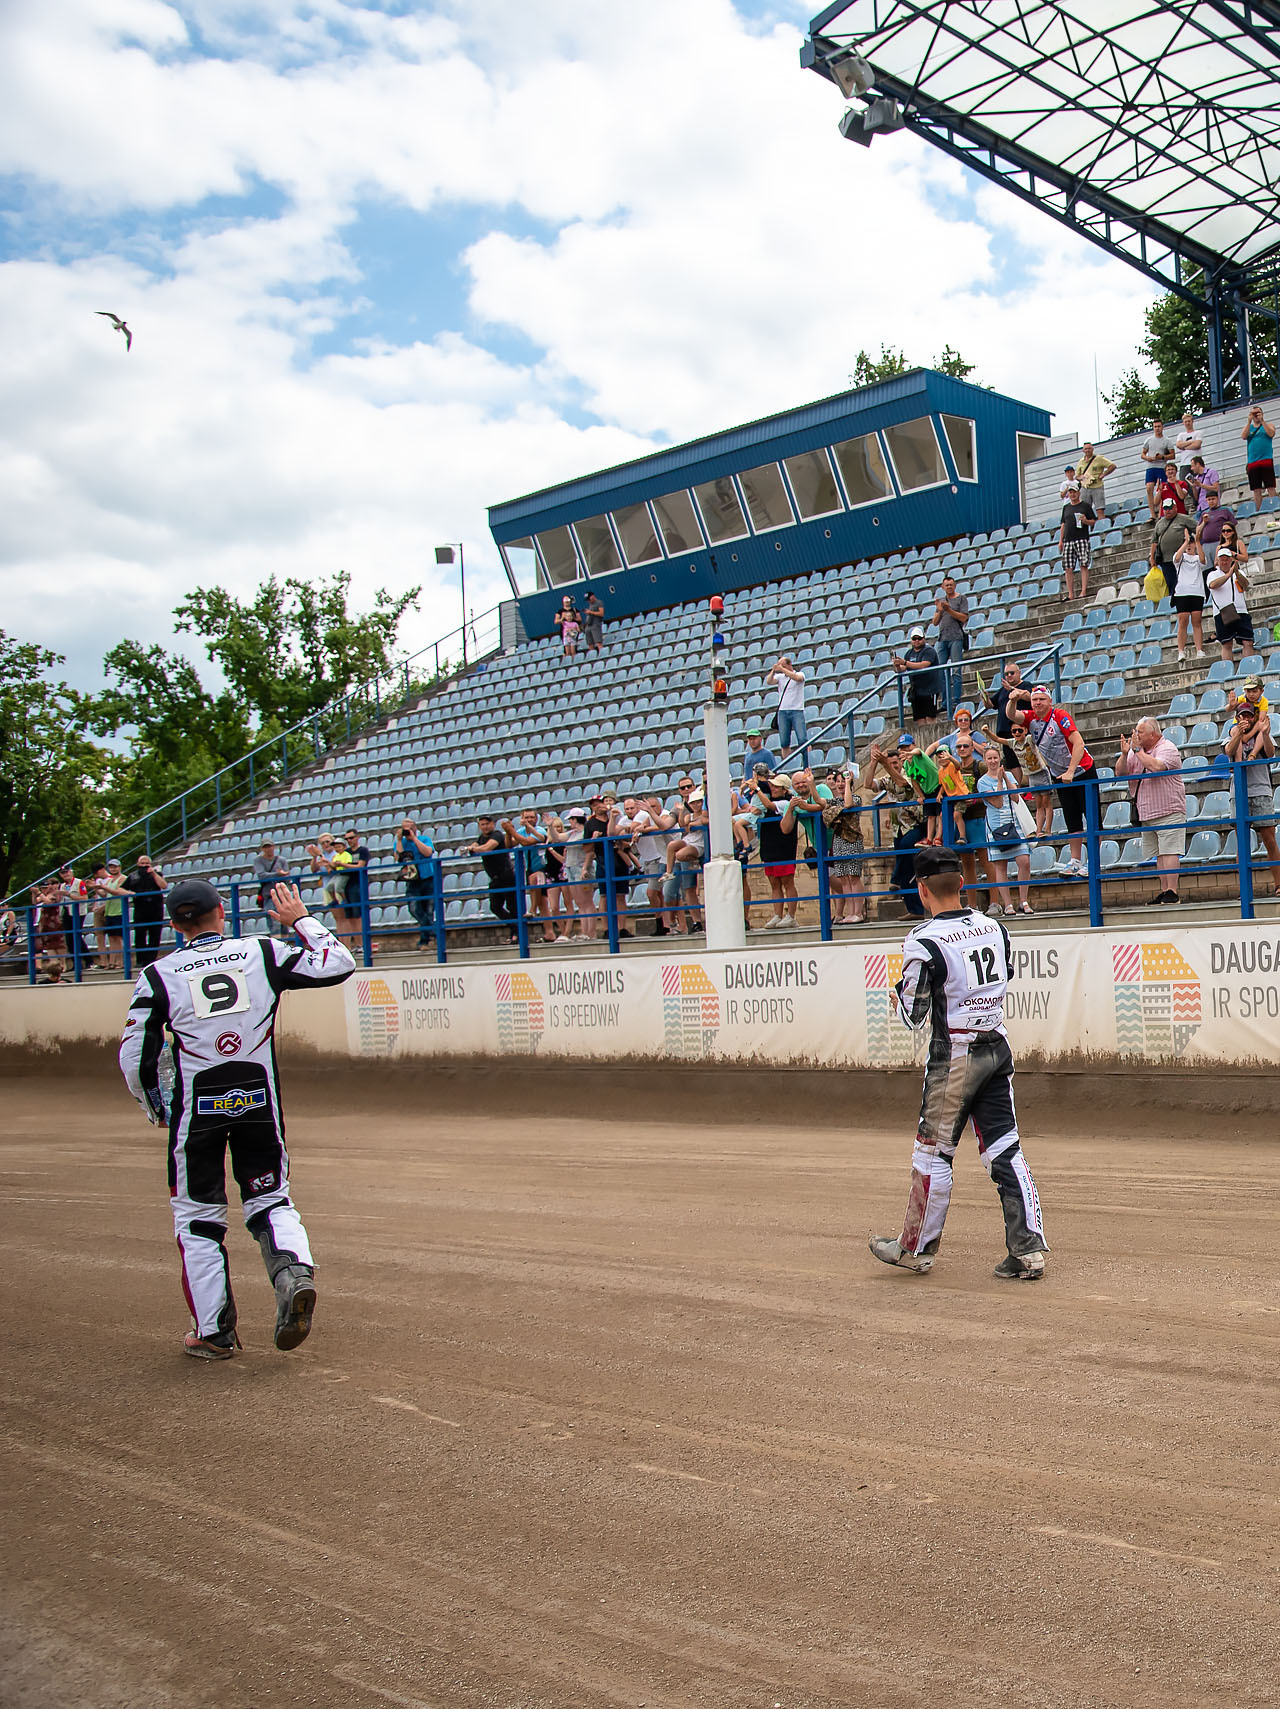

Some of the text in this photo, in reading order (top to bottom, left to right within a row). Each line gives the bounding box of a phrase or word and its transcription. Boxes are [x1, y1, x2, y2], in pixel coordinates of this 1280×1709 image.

[940, 923, 1000, 944] MIHAILOV
[174, 952, 249, 974] KOSTIGOV
[725, 960, 818, 990] DAUGAVPILS
[968, 946, 1000, 986] 12
[200, 973, 239, 1013] 9
[402, 976, 465, 1001] DAUGAVPILS
[548, 969, 625, 996] DAUGAVPILS
[550, 1003, 621, 1028] IS SPEEDWAY
[726, 998, 794, 1025] IR SPORTS
[1212, 987, 1232, 1019] IR
[404, 1007, 451, 1031] IR SPORTS
[213, 1095, 257, 1111] REALL
